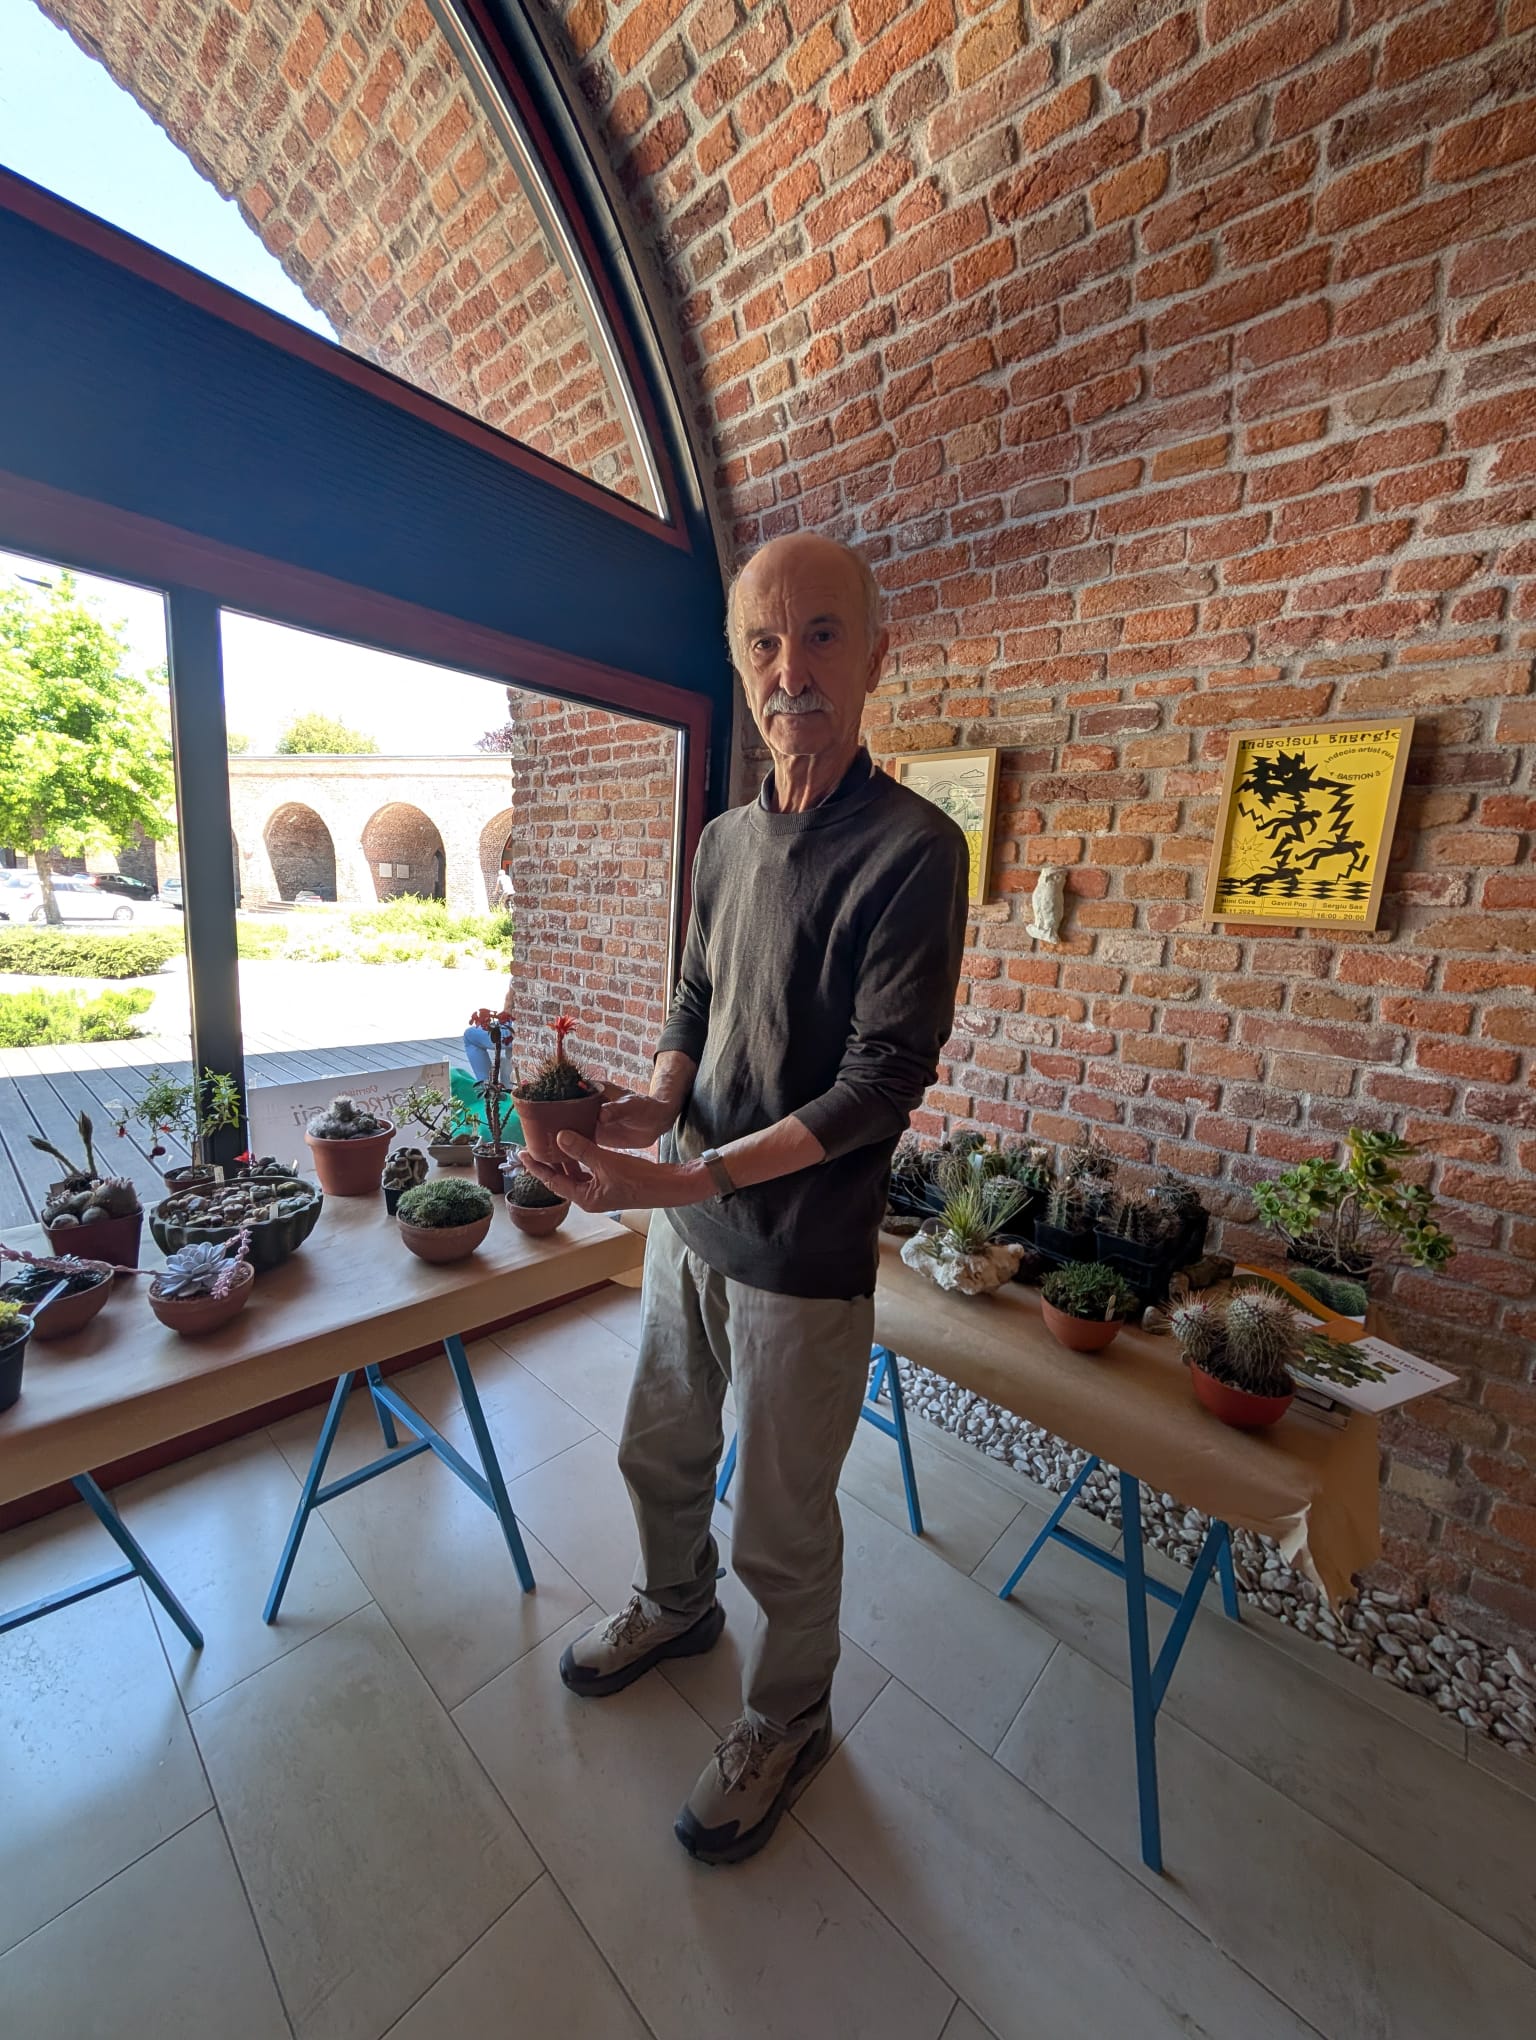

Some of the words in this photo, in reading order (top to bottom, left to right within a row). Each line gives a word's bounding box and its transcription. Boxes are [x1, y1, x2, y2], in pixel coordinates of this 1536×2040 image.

[1358, 746, 1381, 754] artist
[1381, 749, 1395, 760] run
[1337, 771, 1374, 781] BASTION
[1293, 900, 1307, 908] Pop
